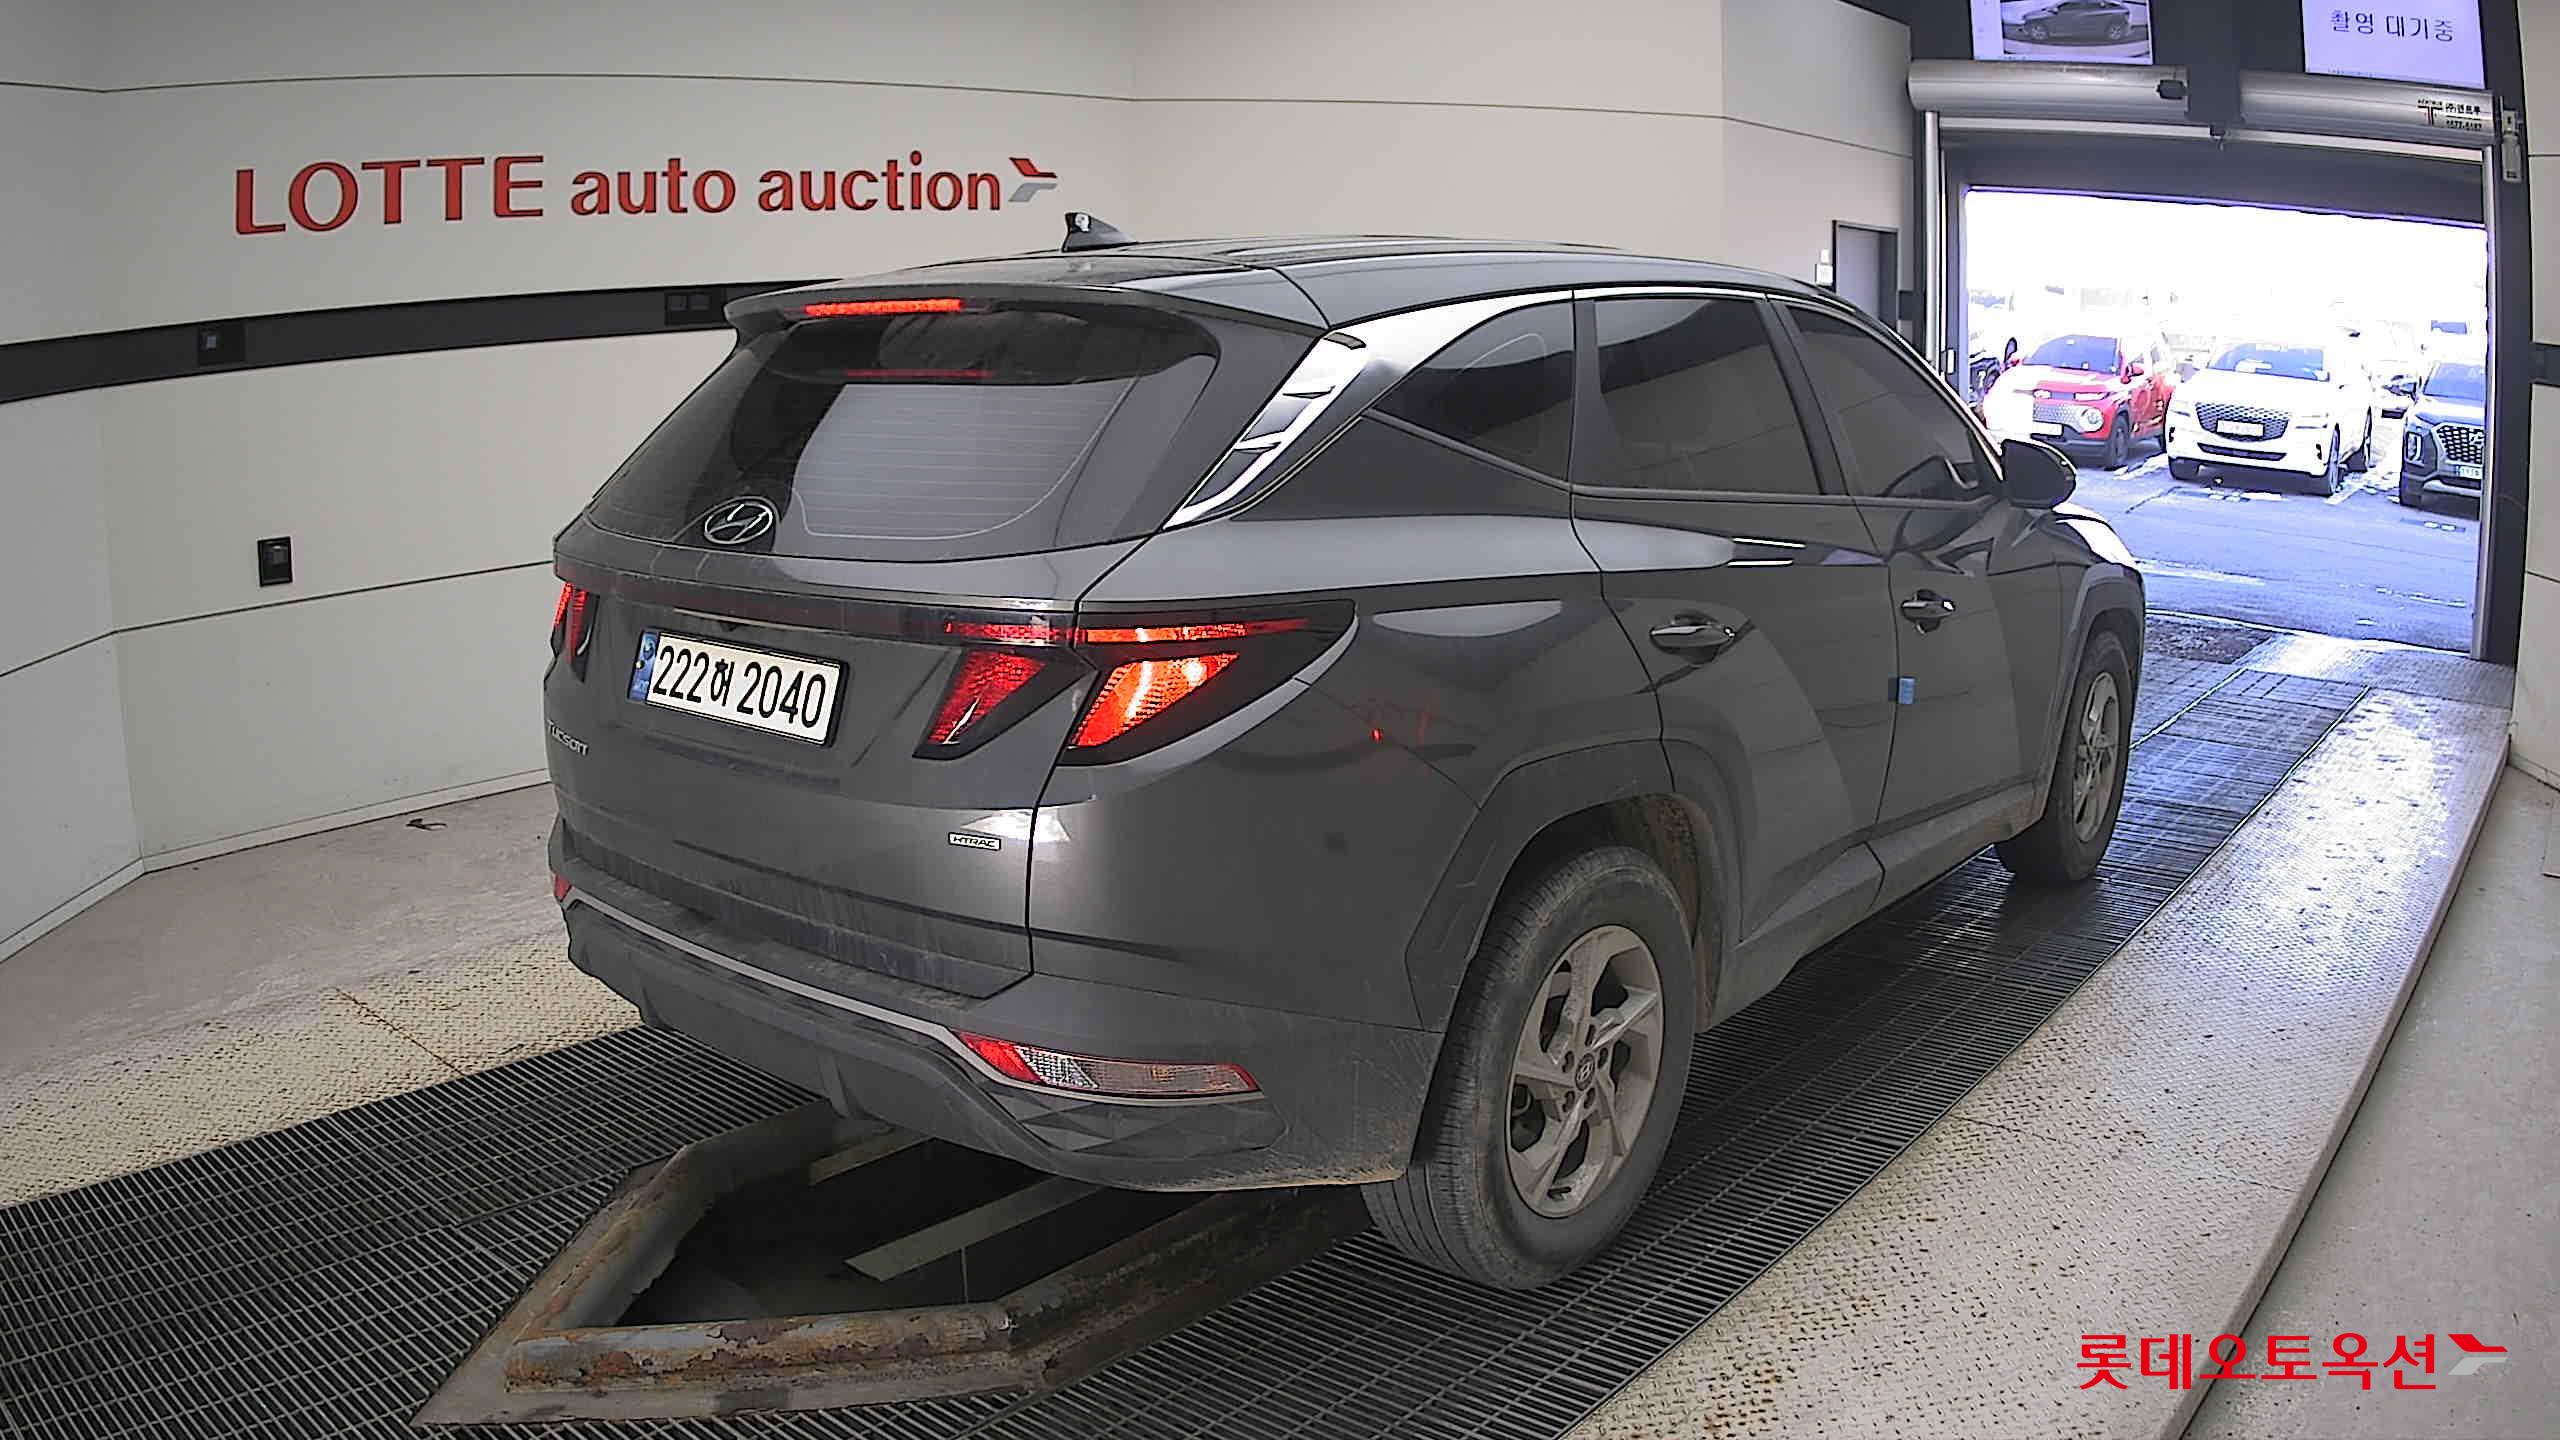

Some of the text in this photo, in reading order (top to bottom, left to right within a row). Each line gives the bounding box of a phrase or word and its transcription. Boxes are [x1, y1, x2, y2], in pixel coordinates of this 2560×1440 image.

[2331, 10, 2453, 42] 촬영 대기중
[234, 150, 1003, 235] LOTTE auto auction
[652, 645, 826, 729] 222허 2040
[953, 836, 996, 848] HTRAC
